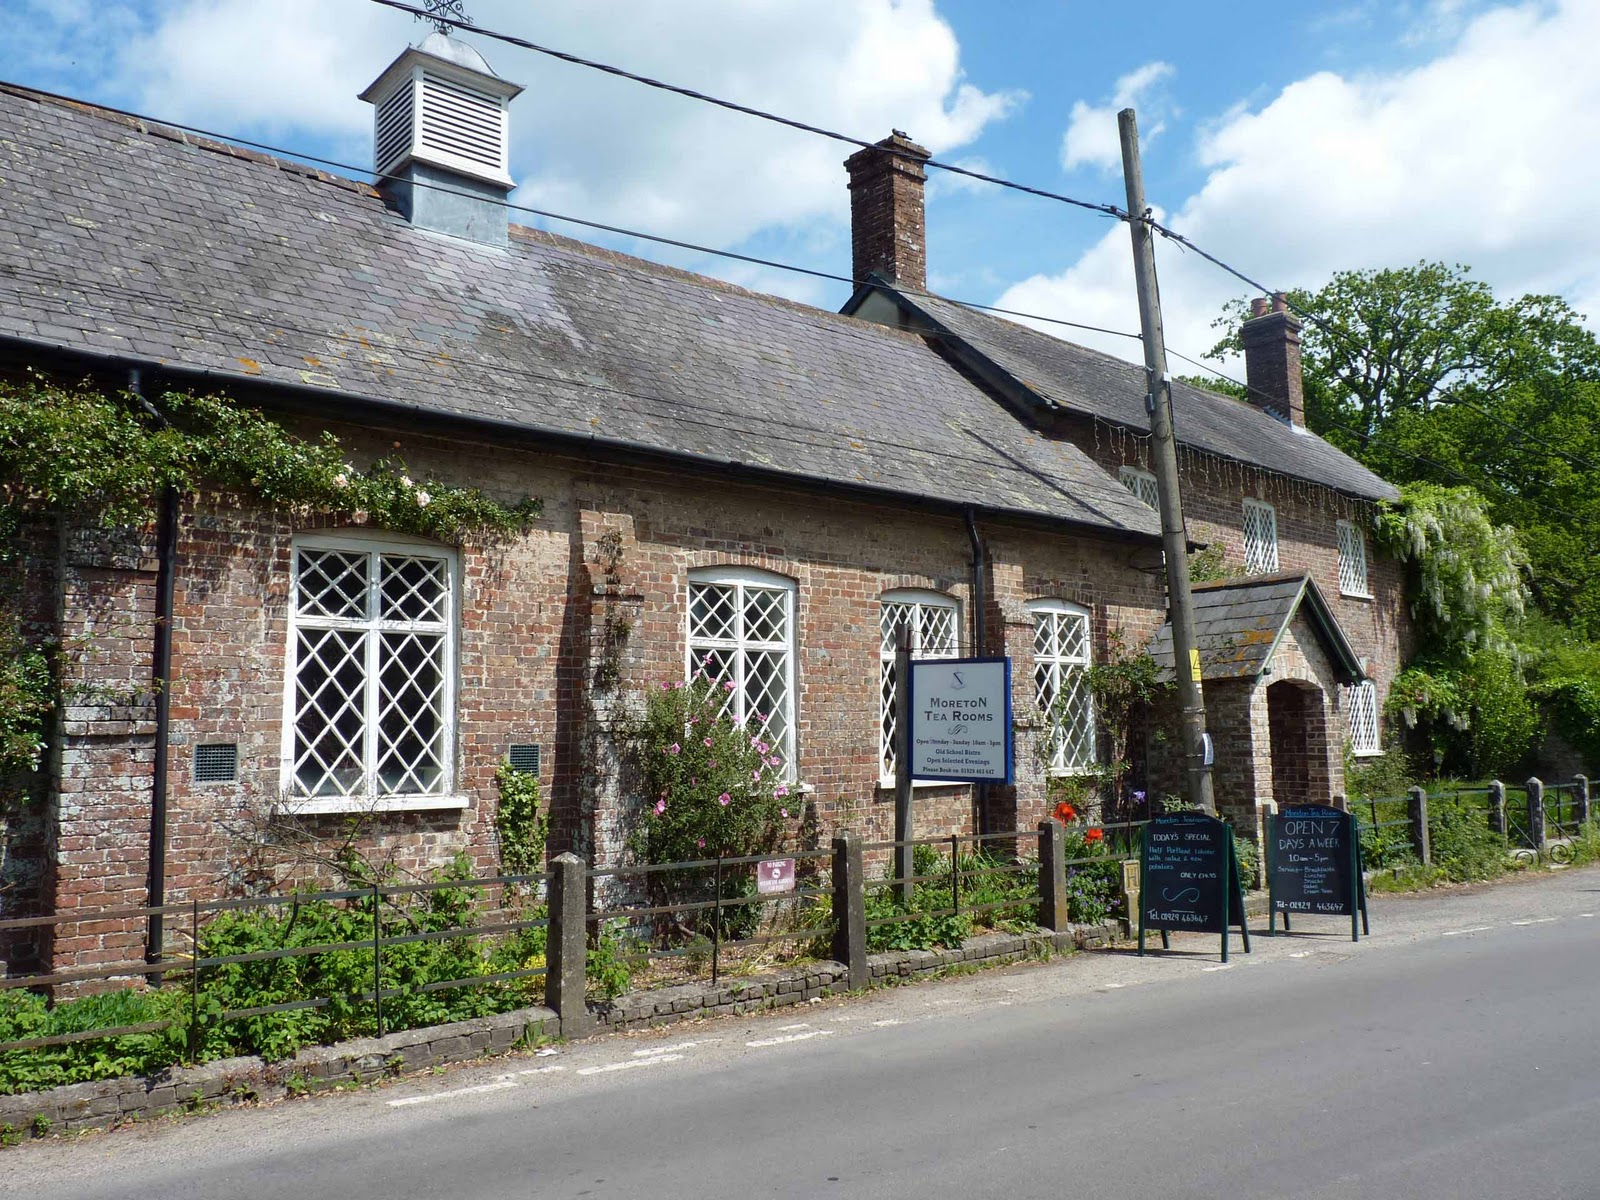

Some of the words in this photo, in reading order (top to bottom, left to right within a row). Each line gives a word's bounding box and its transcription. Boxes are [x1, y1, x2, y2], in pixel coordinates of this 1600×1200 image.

[926, 757, 941, 765] Open
[1285, 821, 1324, 836] OPEN
[1329, 821, 1340, 835] 7
[1184, 833, 1211, 841] SPECIAL
[1279, 838, 1305, 850] DAYS
[1308, 838, 1316, 849] A
[1316, 838, 1340, 849] WEEK
[1149, 846, 1163, 854] Half
[1148, 863, 1174, 871] potatoes
